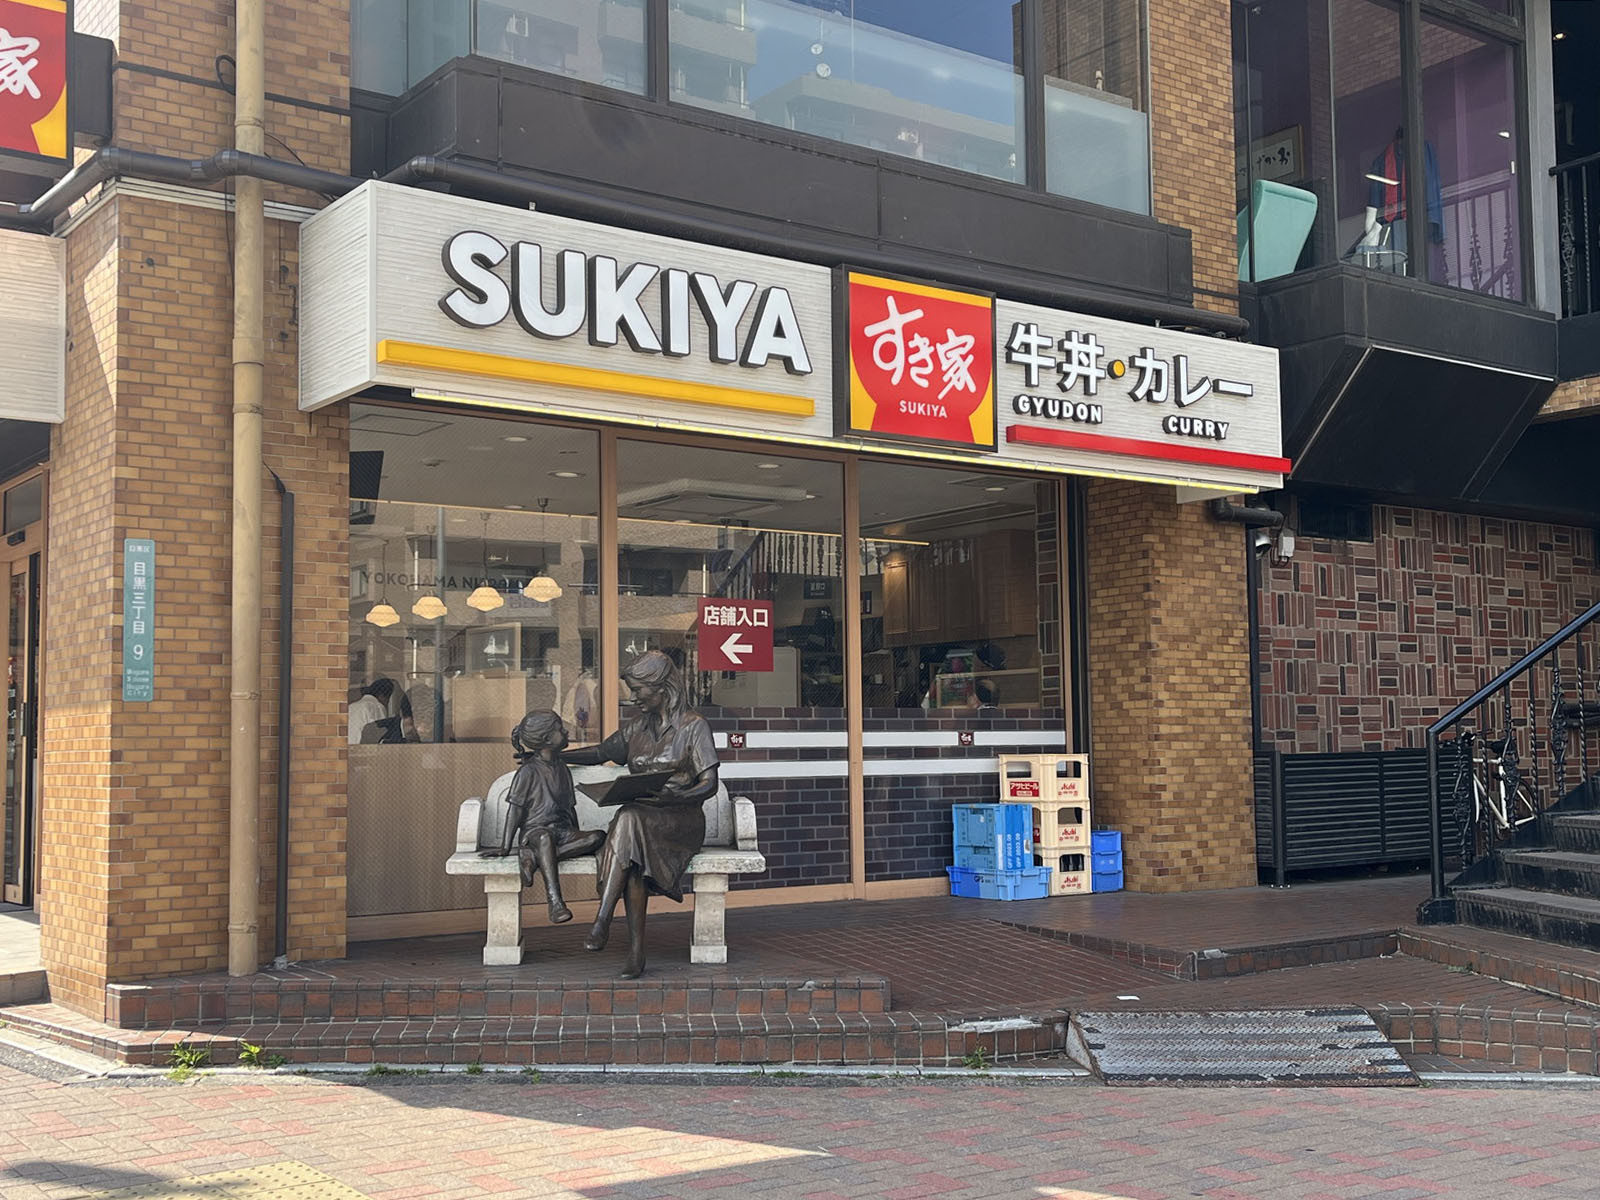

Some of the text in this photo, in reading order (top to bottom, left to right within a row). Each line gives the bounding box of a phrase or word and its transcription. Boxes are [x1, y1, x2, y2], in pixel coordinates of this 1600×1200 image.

[438, 230, 813, 376] SUKIYA
[864, 295, 977, 400] すき家
[1005, 322, 1254, 408] 牛丼・カレー
[899, 399, 948, 419] SUKIYA
[1012, 394, 1103, 425] GYUDON
[1162, 415, 1230, 441] CURRY
[131, 561, 147, 661] 目黒三丁目 9
[703, 604, 769, 628] 店舗入口
